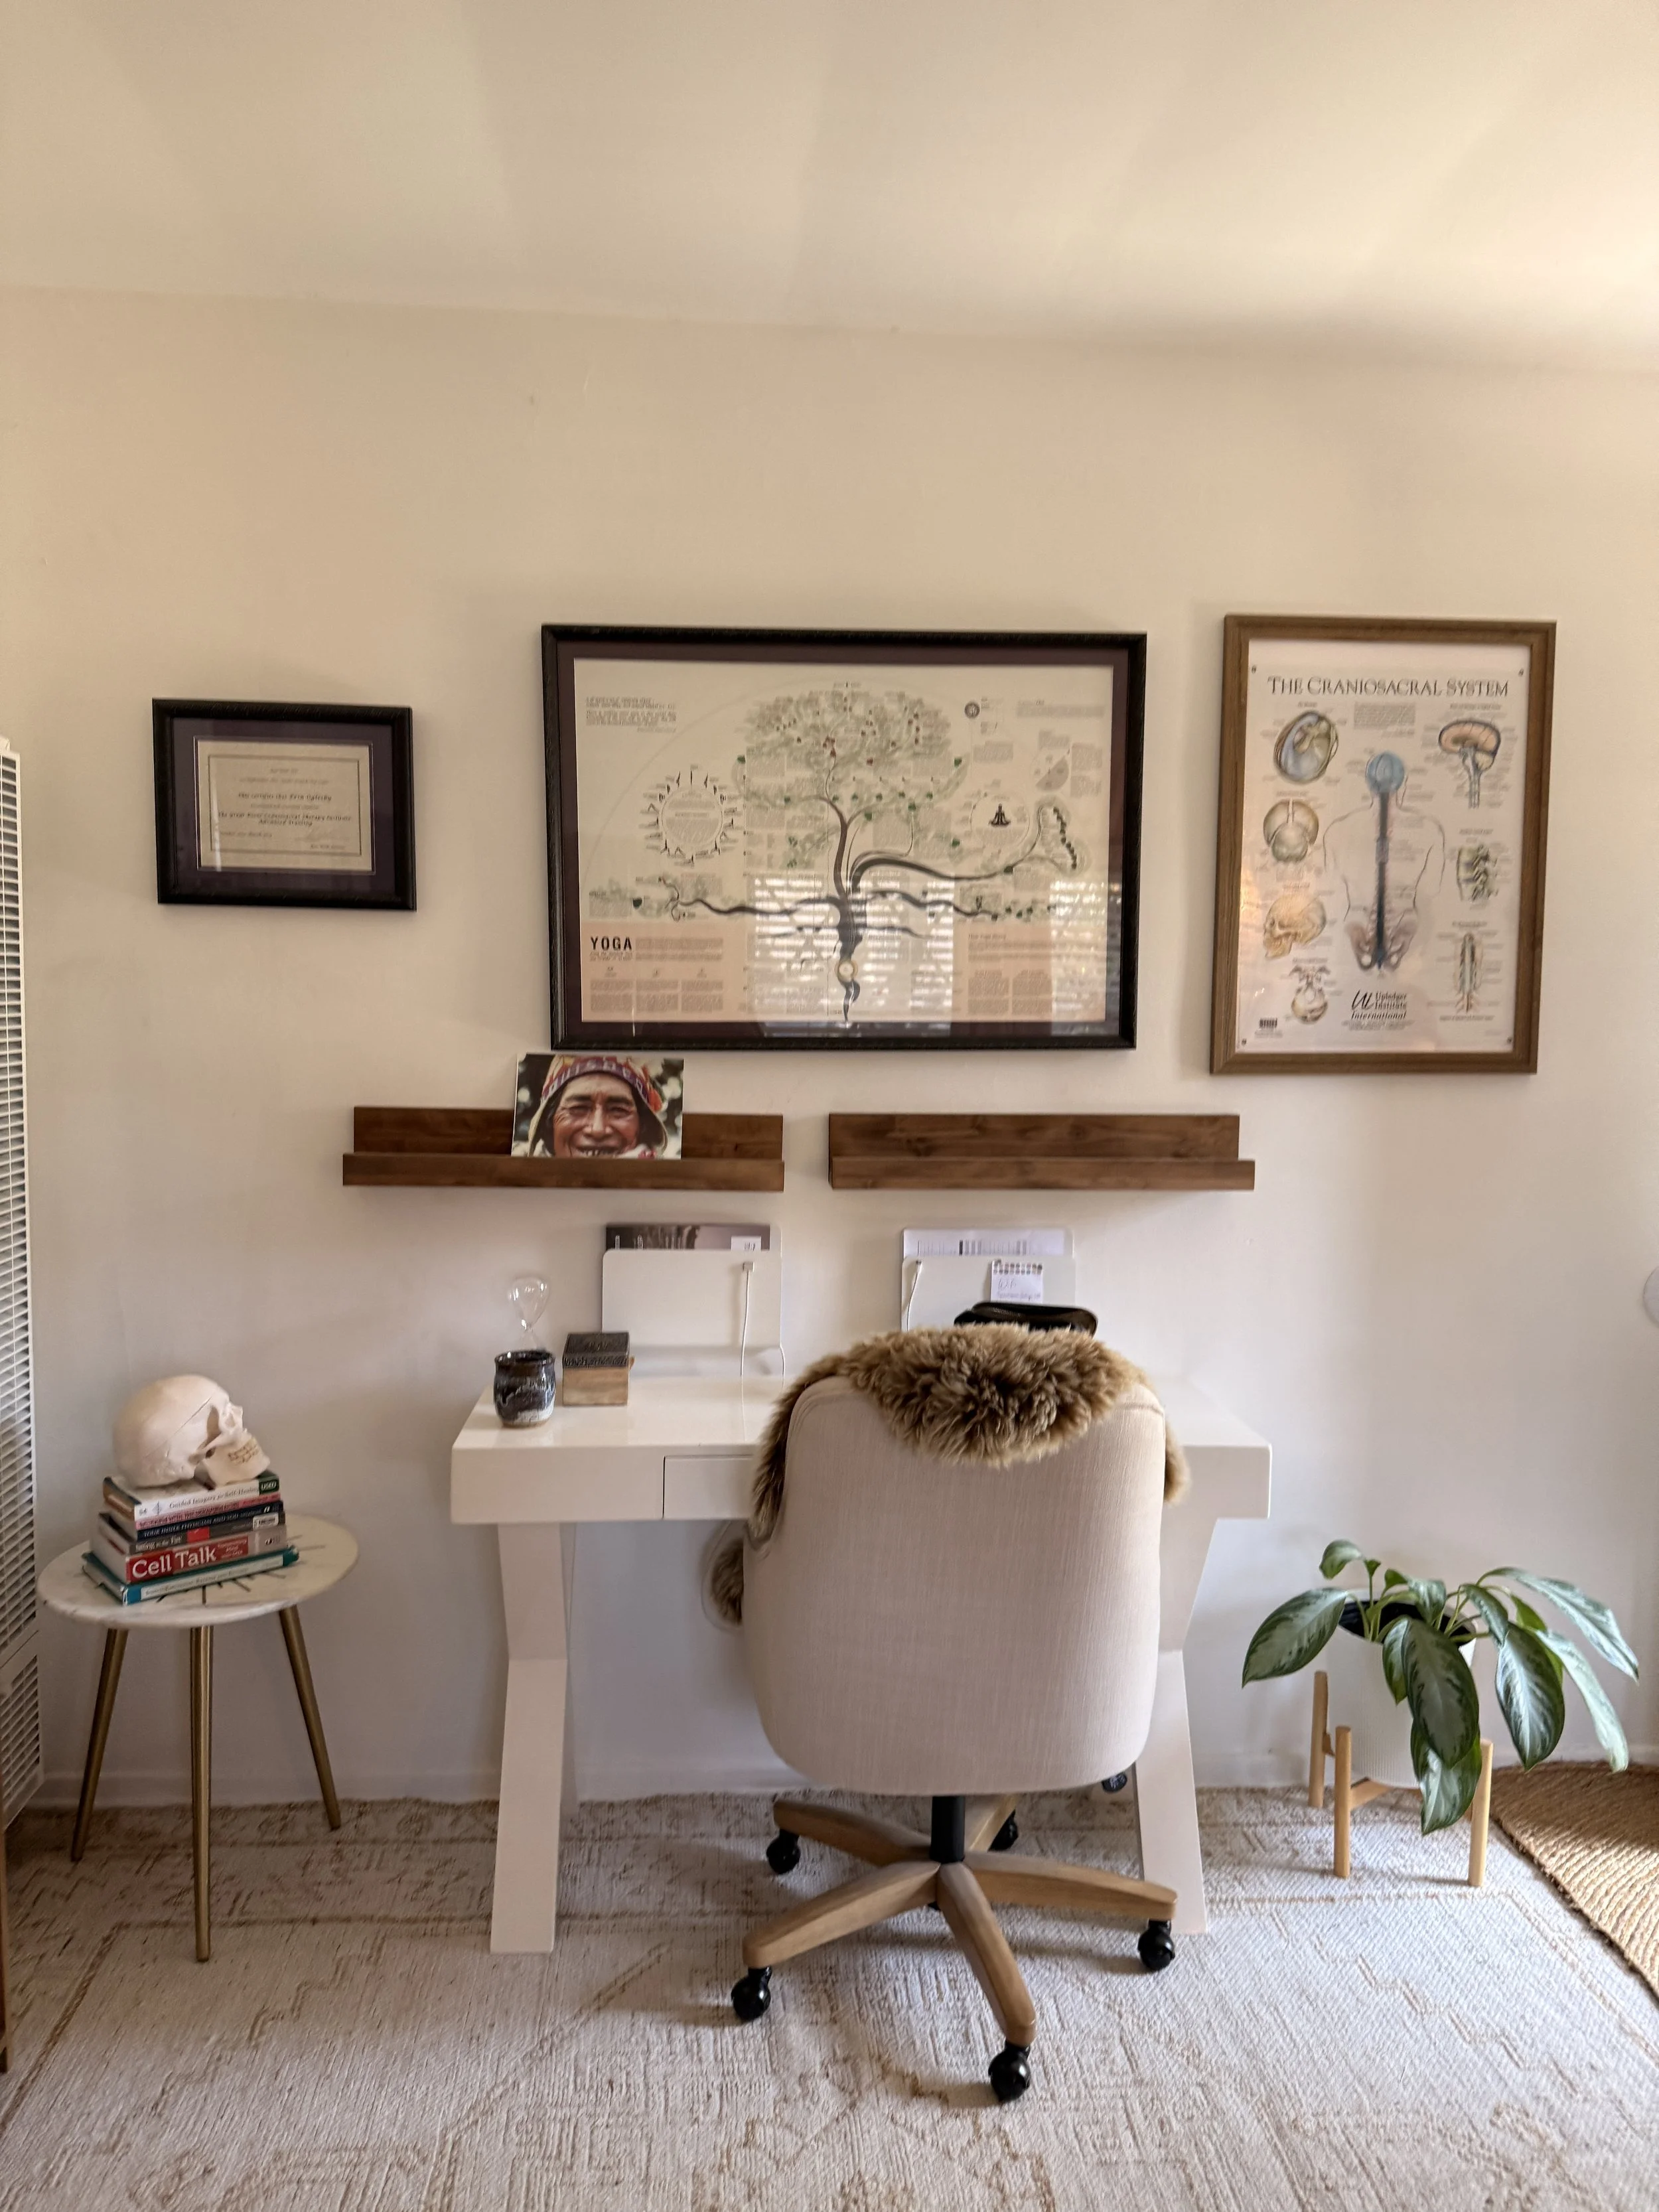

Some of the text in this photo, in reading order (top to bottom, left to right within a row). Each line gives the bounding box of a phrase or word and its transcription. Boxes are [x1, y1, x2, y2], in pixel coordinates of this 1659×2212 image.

[1267, 676, 1509, 698] THE CRANIOSACRAL SYSTEM
[590, 936, 632, 951] YOGA
[1350, 1010, 1407, 1020] International
[261, 1481, 277, 1491] USED
[169, 1498, 191, 1509] Guided
[132, 1544, 218, 1579] Cell Talk
